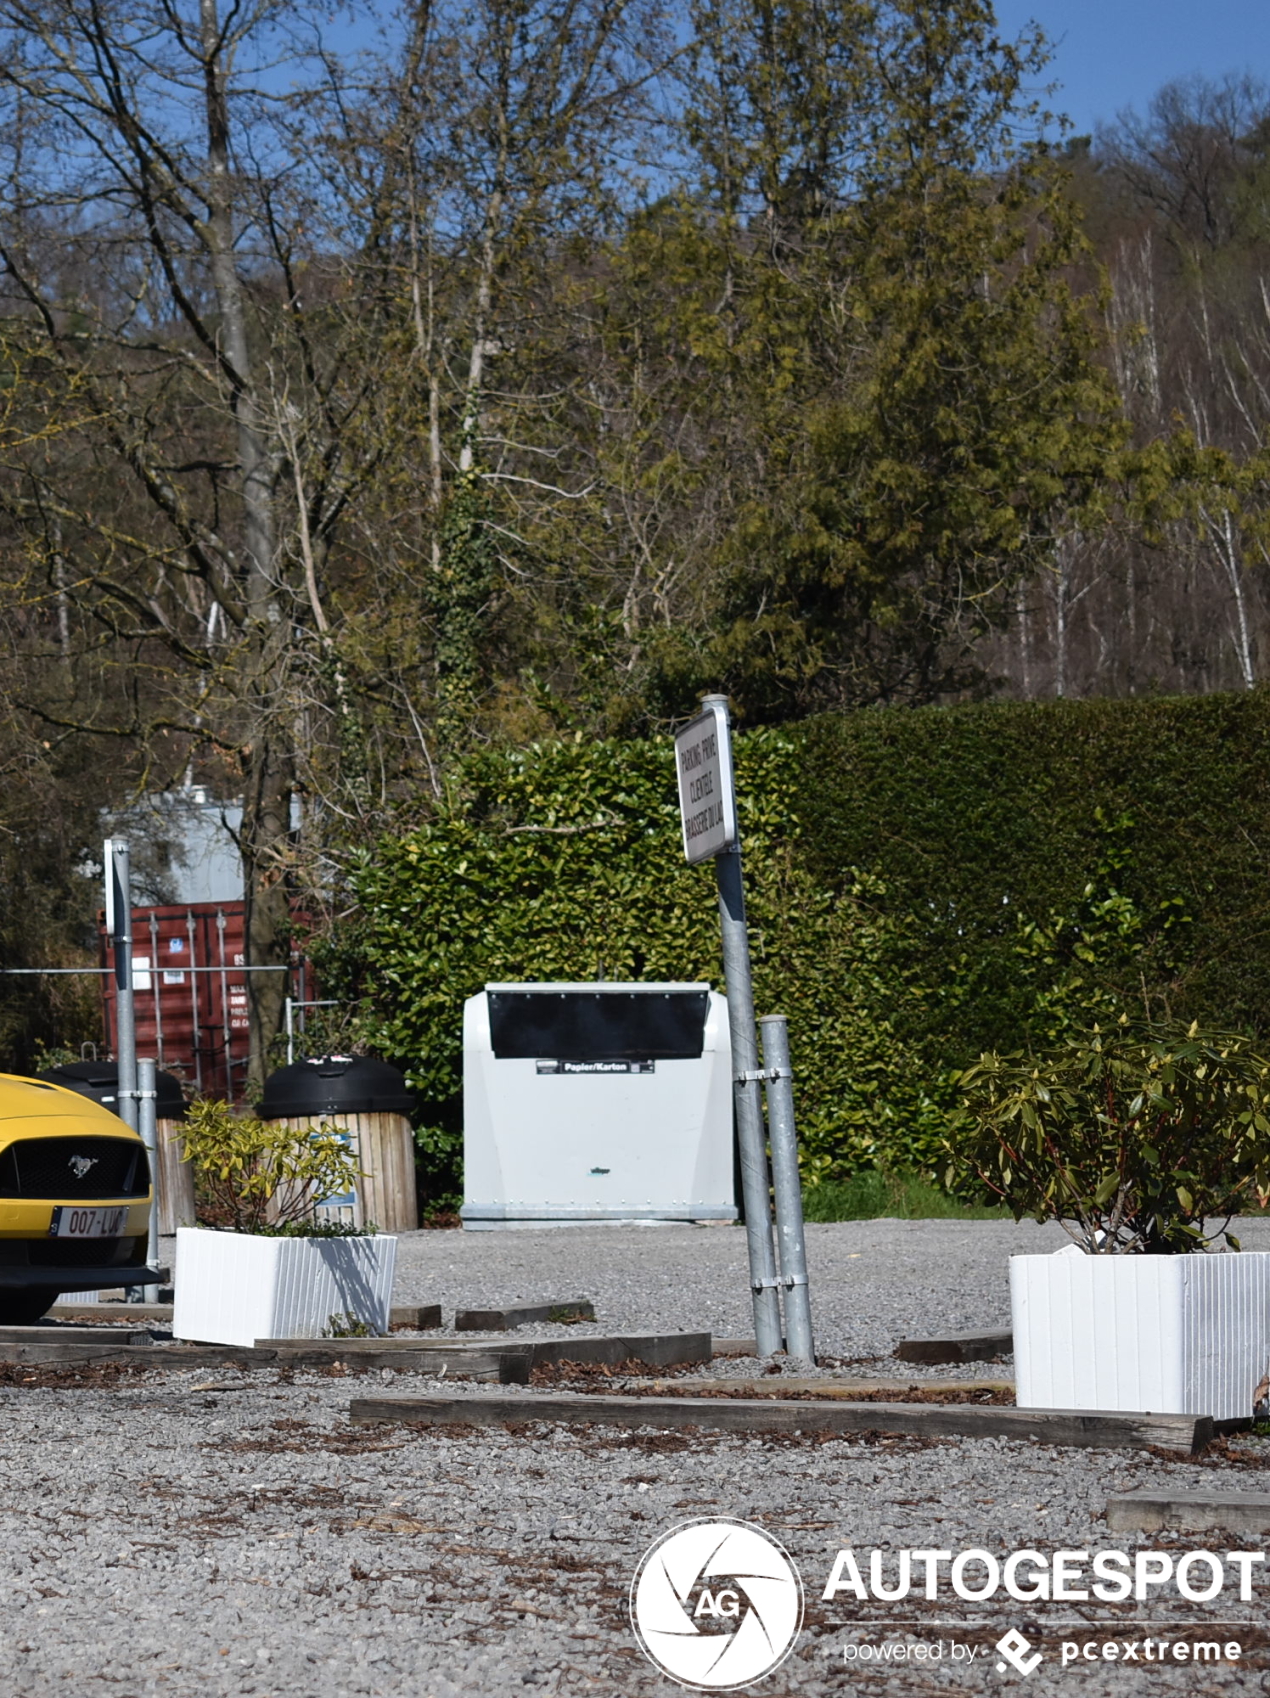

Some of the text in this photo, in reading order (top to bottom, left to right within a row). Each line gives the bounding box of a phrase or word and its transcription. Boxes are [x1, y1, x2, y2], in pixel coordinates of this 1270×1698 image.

[681, 743, 701, 774] PARKING
[685, 808, 709, 841] BRASSERIE
[564, 1062, 627, 1072] Papier/Karton
[68, 1210, 123, 1234] 007-LUC
